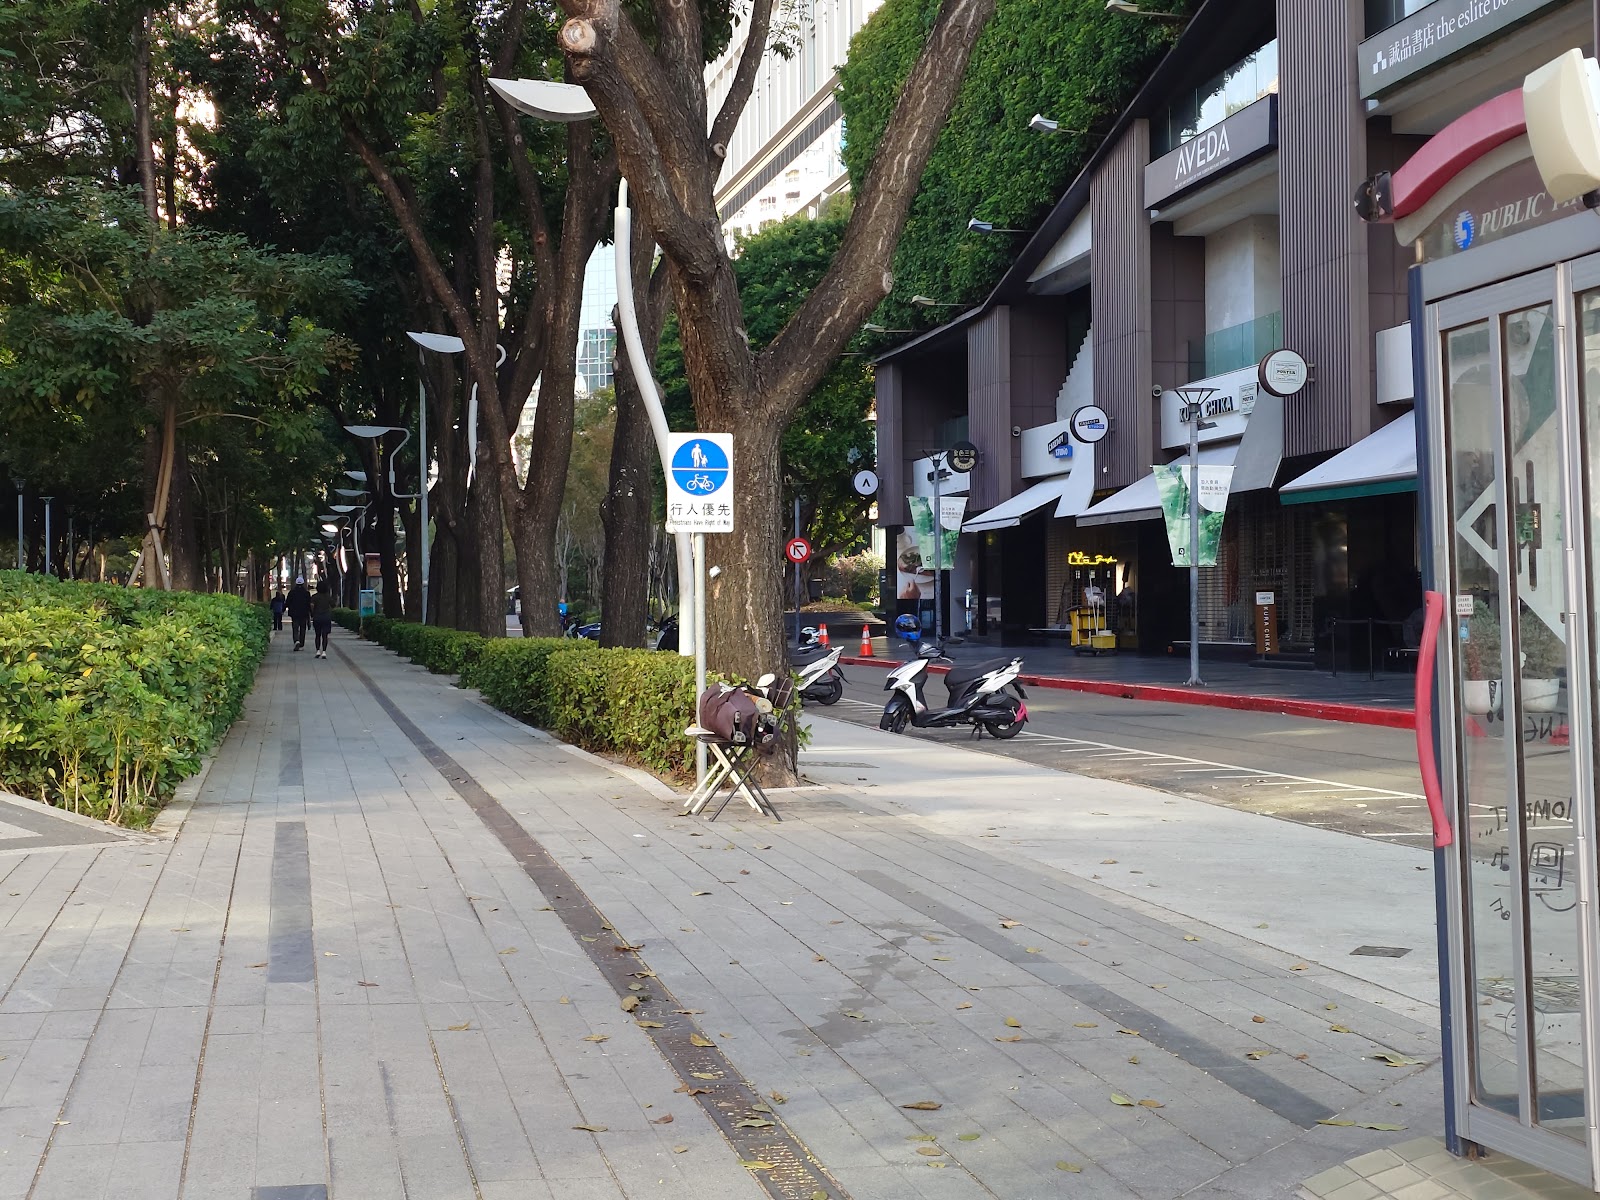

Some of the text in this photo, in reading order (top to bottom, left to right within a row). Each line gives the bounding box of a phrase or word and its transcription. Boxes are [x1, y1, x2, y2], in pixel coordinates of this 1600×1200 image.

[1388, 0, 1491, 68] 誠品書店 the eslite
[1174, 124, 1230, 181] AVEDA
[1478, 192, 1547, 237] PUBLIC
[1205, 396, 1233, 416] CHIKA
[670, 502, 731, 516] 行人優先
[704, 519, 716, 527] Right
